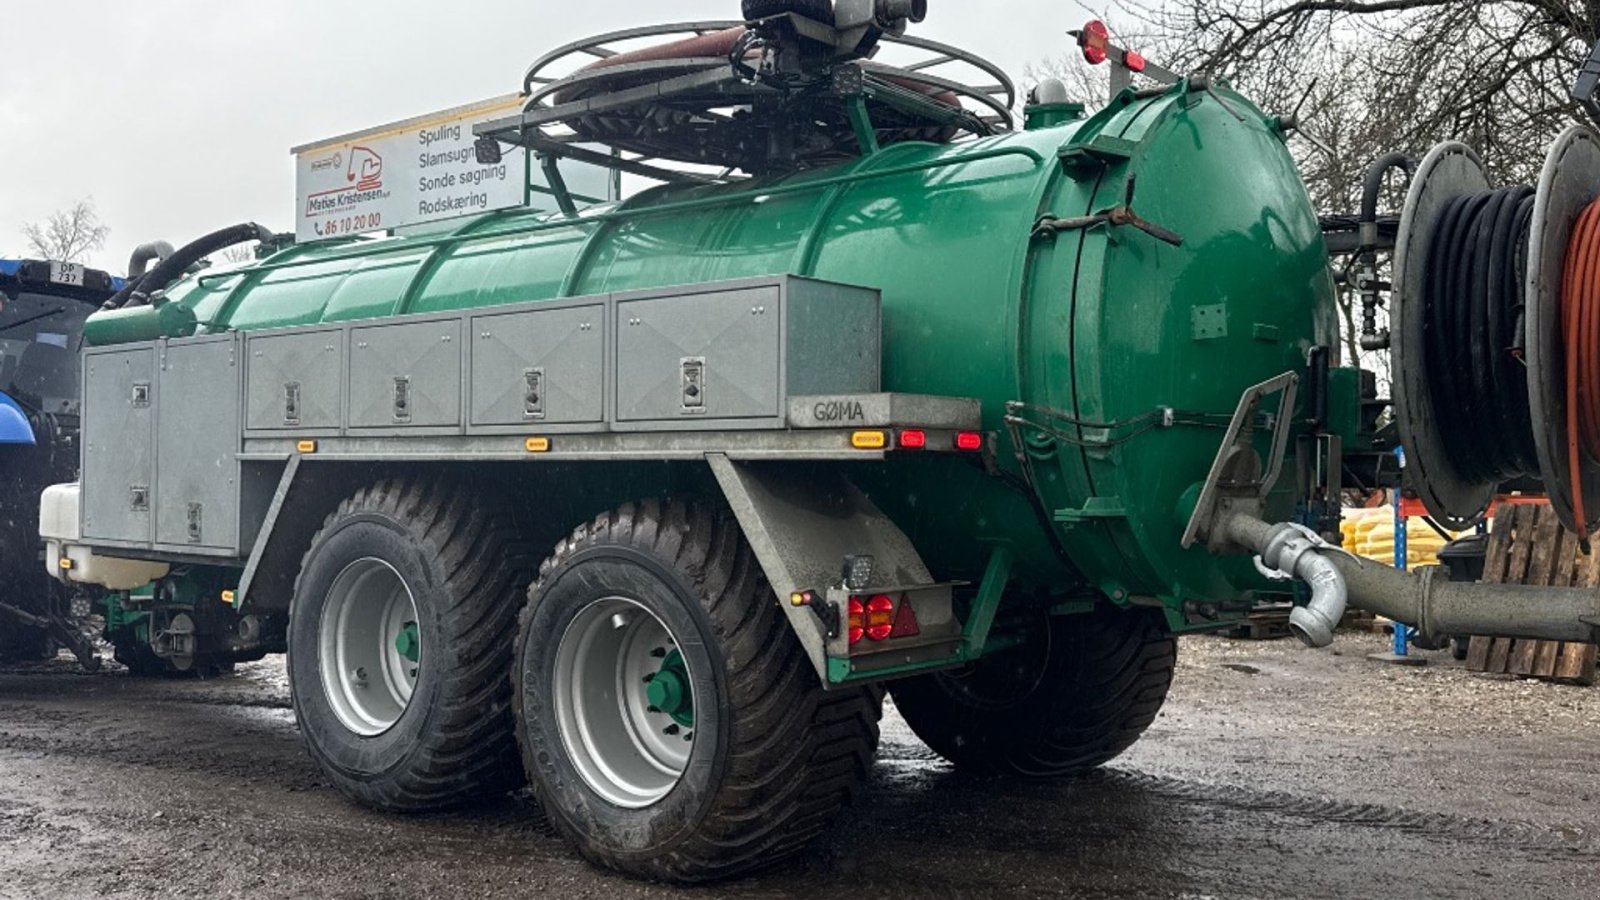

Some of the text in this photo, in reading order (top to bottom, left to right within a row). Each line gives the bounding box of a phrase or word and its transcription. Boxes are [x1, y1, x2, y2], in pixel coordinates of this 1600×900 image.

[419, 125, 460, 146] Spuling
[419, 147, 474, 168] Slamsugn
[419, 172, 455, 192] Sonde
[309, 195, 336, 211] Matias
[337, 190, 382, 206] Kristensen
[419, 191, 487, 215] Rodskæring
[325, 212, 381, 235] 86 10 20 00
[814, 402, 864, 422] GØMA
